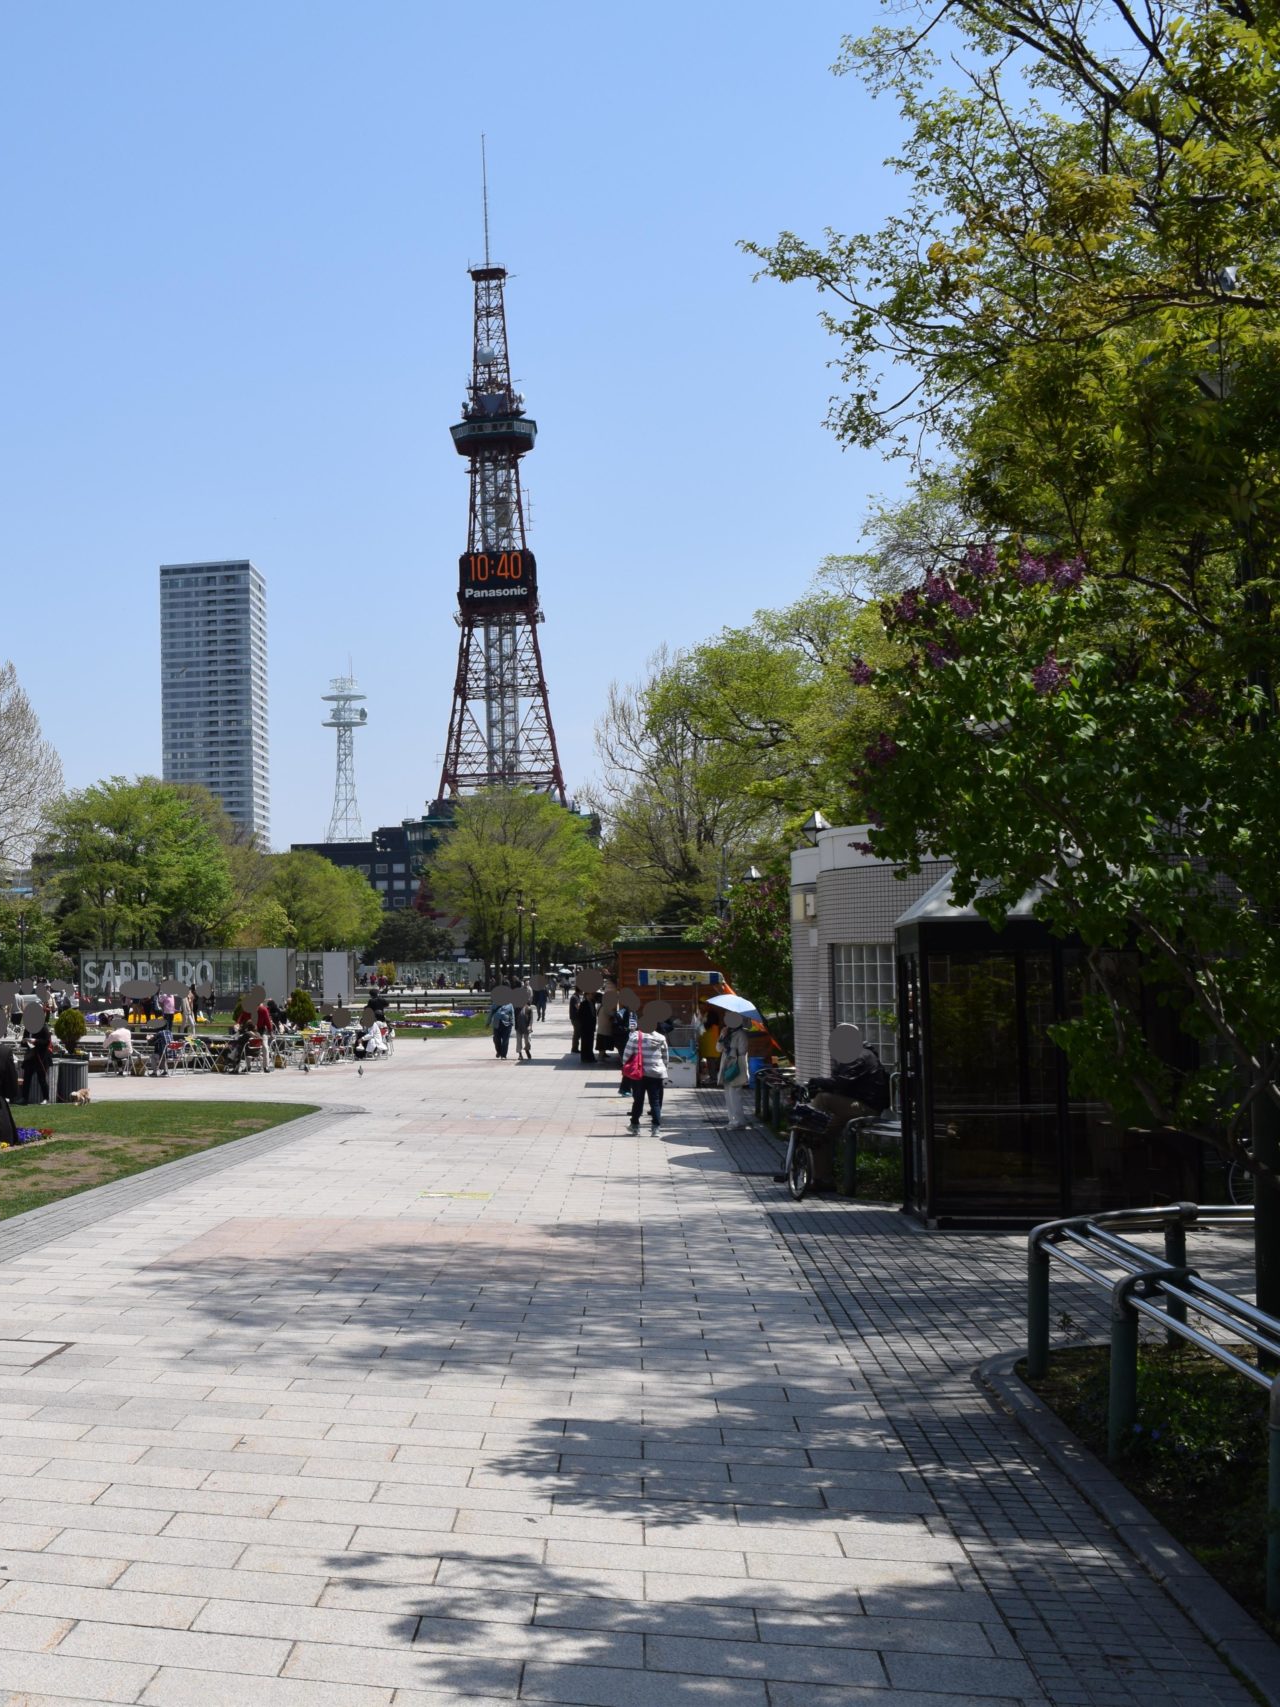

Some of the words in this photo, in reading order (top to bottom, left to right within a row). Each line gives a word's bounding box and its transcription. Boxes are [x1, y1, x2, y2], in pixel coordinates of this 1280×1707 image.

[469, 552, 522, 581] 10:40
[465, 586, 528, 598] Panasonic
[84, 960, 214, 991] SAPPRO
